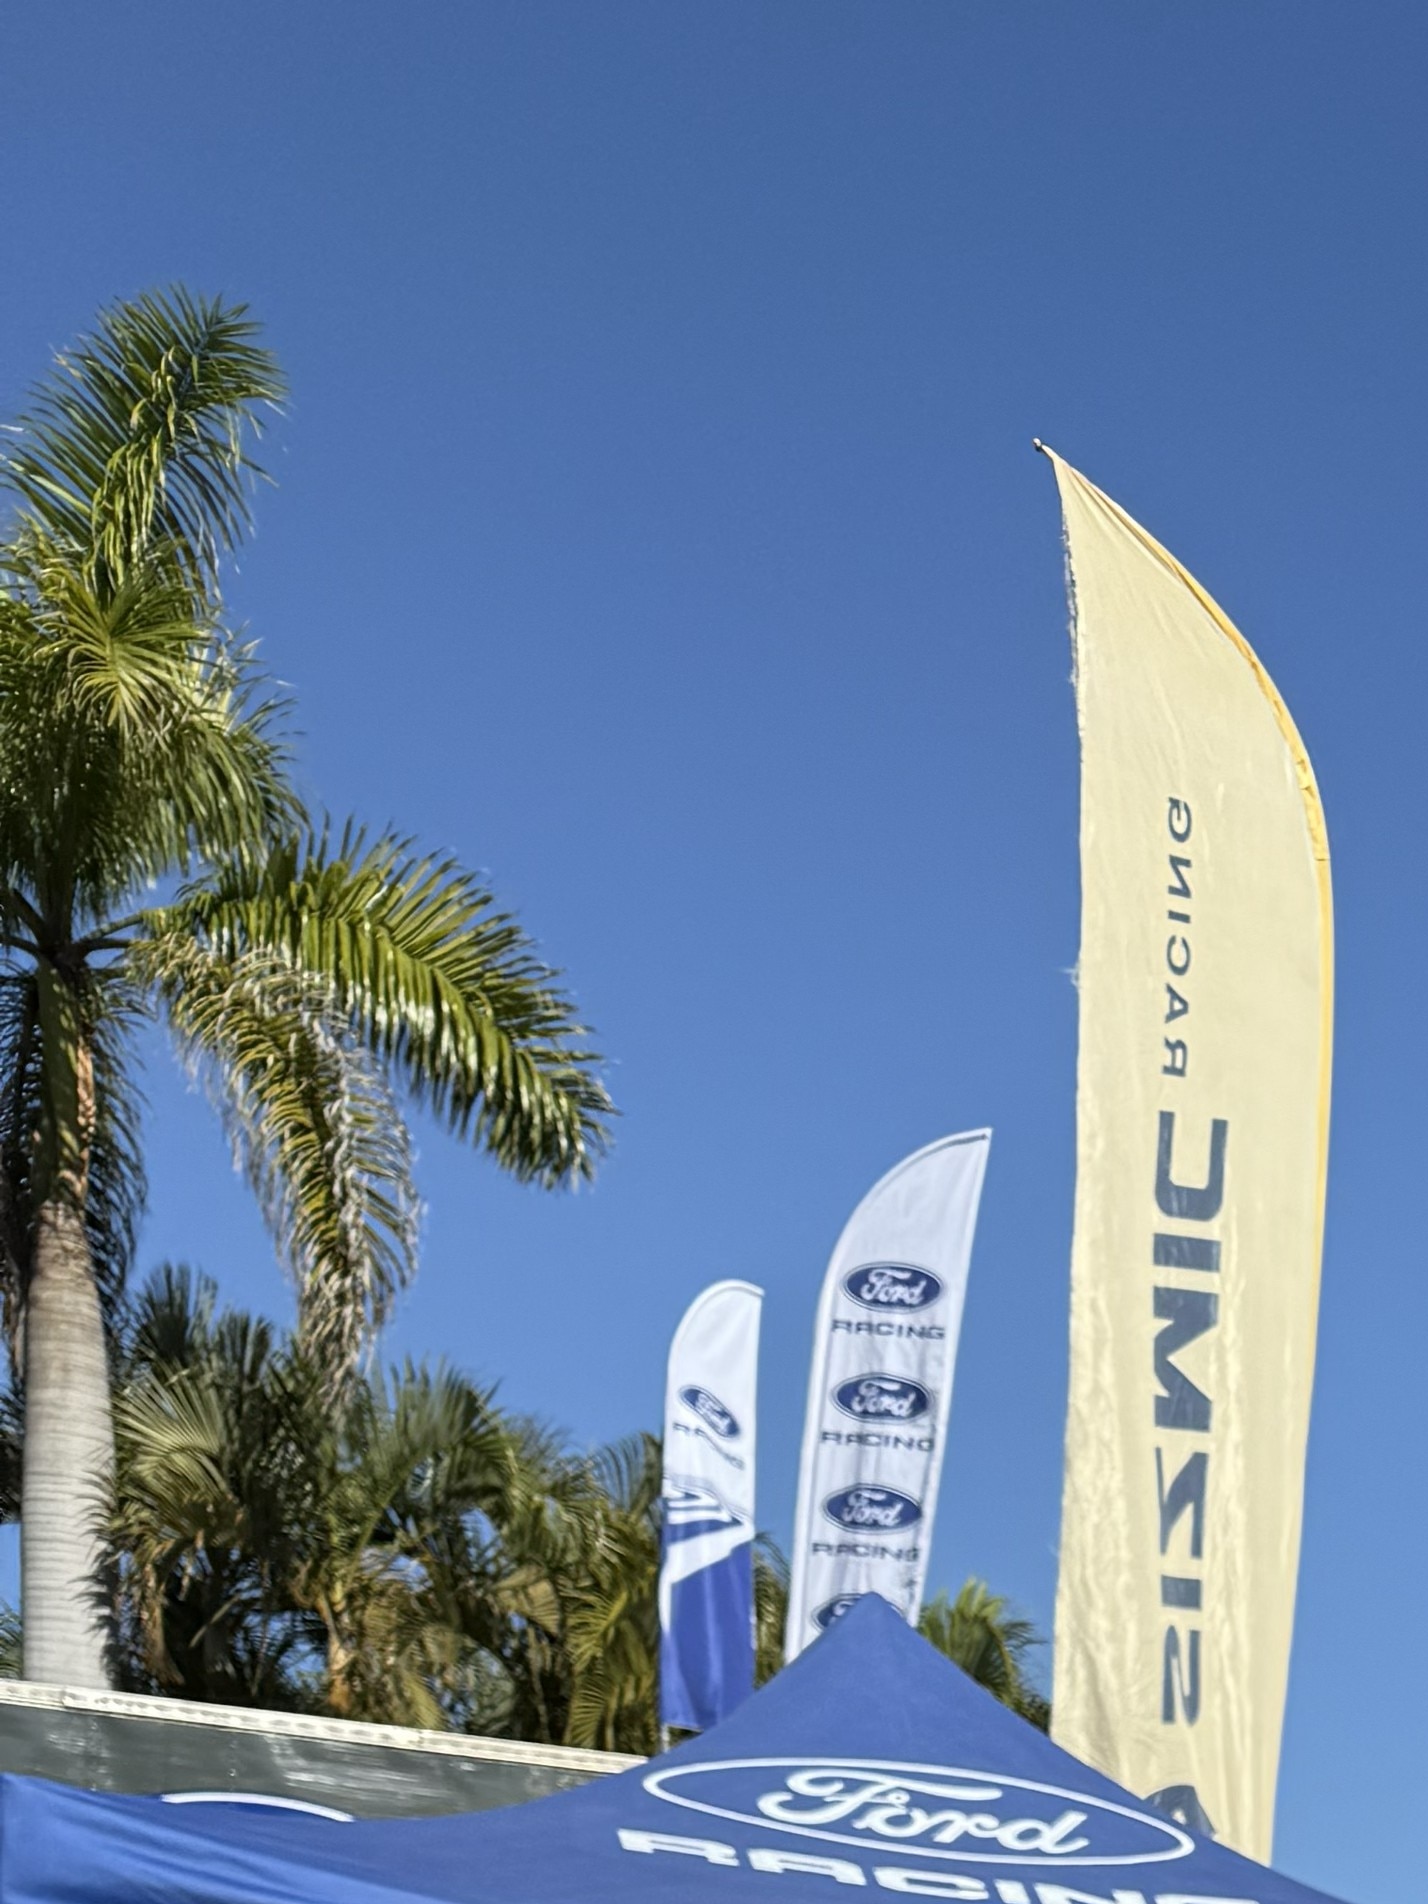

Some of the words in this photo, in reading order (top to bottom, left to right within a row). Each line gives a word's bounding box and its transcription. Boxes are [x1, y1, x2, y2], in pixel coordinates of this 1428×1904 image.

[861, 1269, 923, 1306] Ford
[831, 1319, 946, 1340] RACING
[854, 1381, 914, 1417] Ford
[820, 1431, 935, 1451] RACING
[843, 1491, 901, 1527] Ford
[812, 1543, 920, 1563] RACING
[757, 1768, 1091, 1856] Ford
